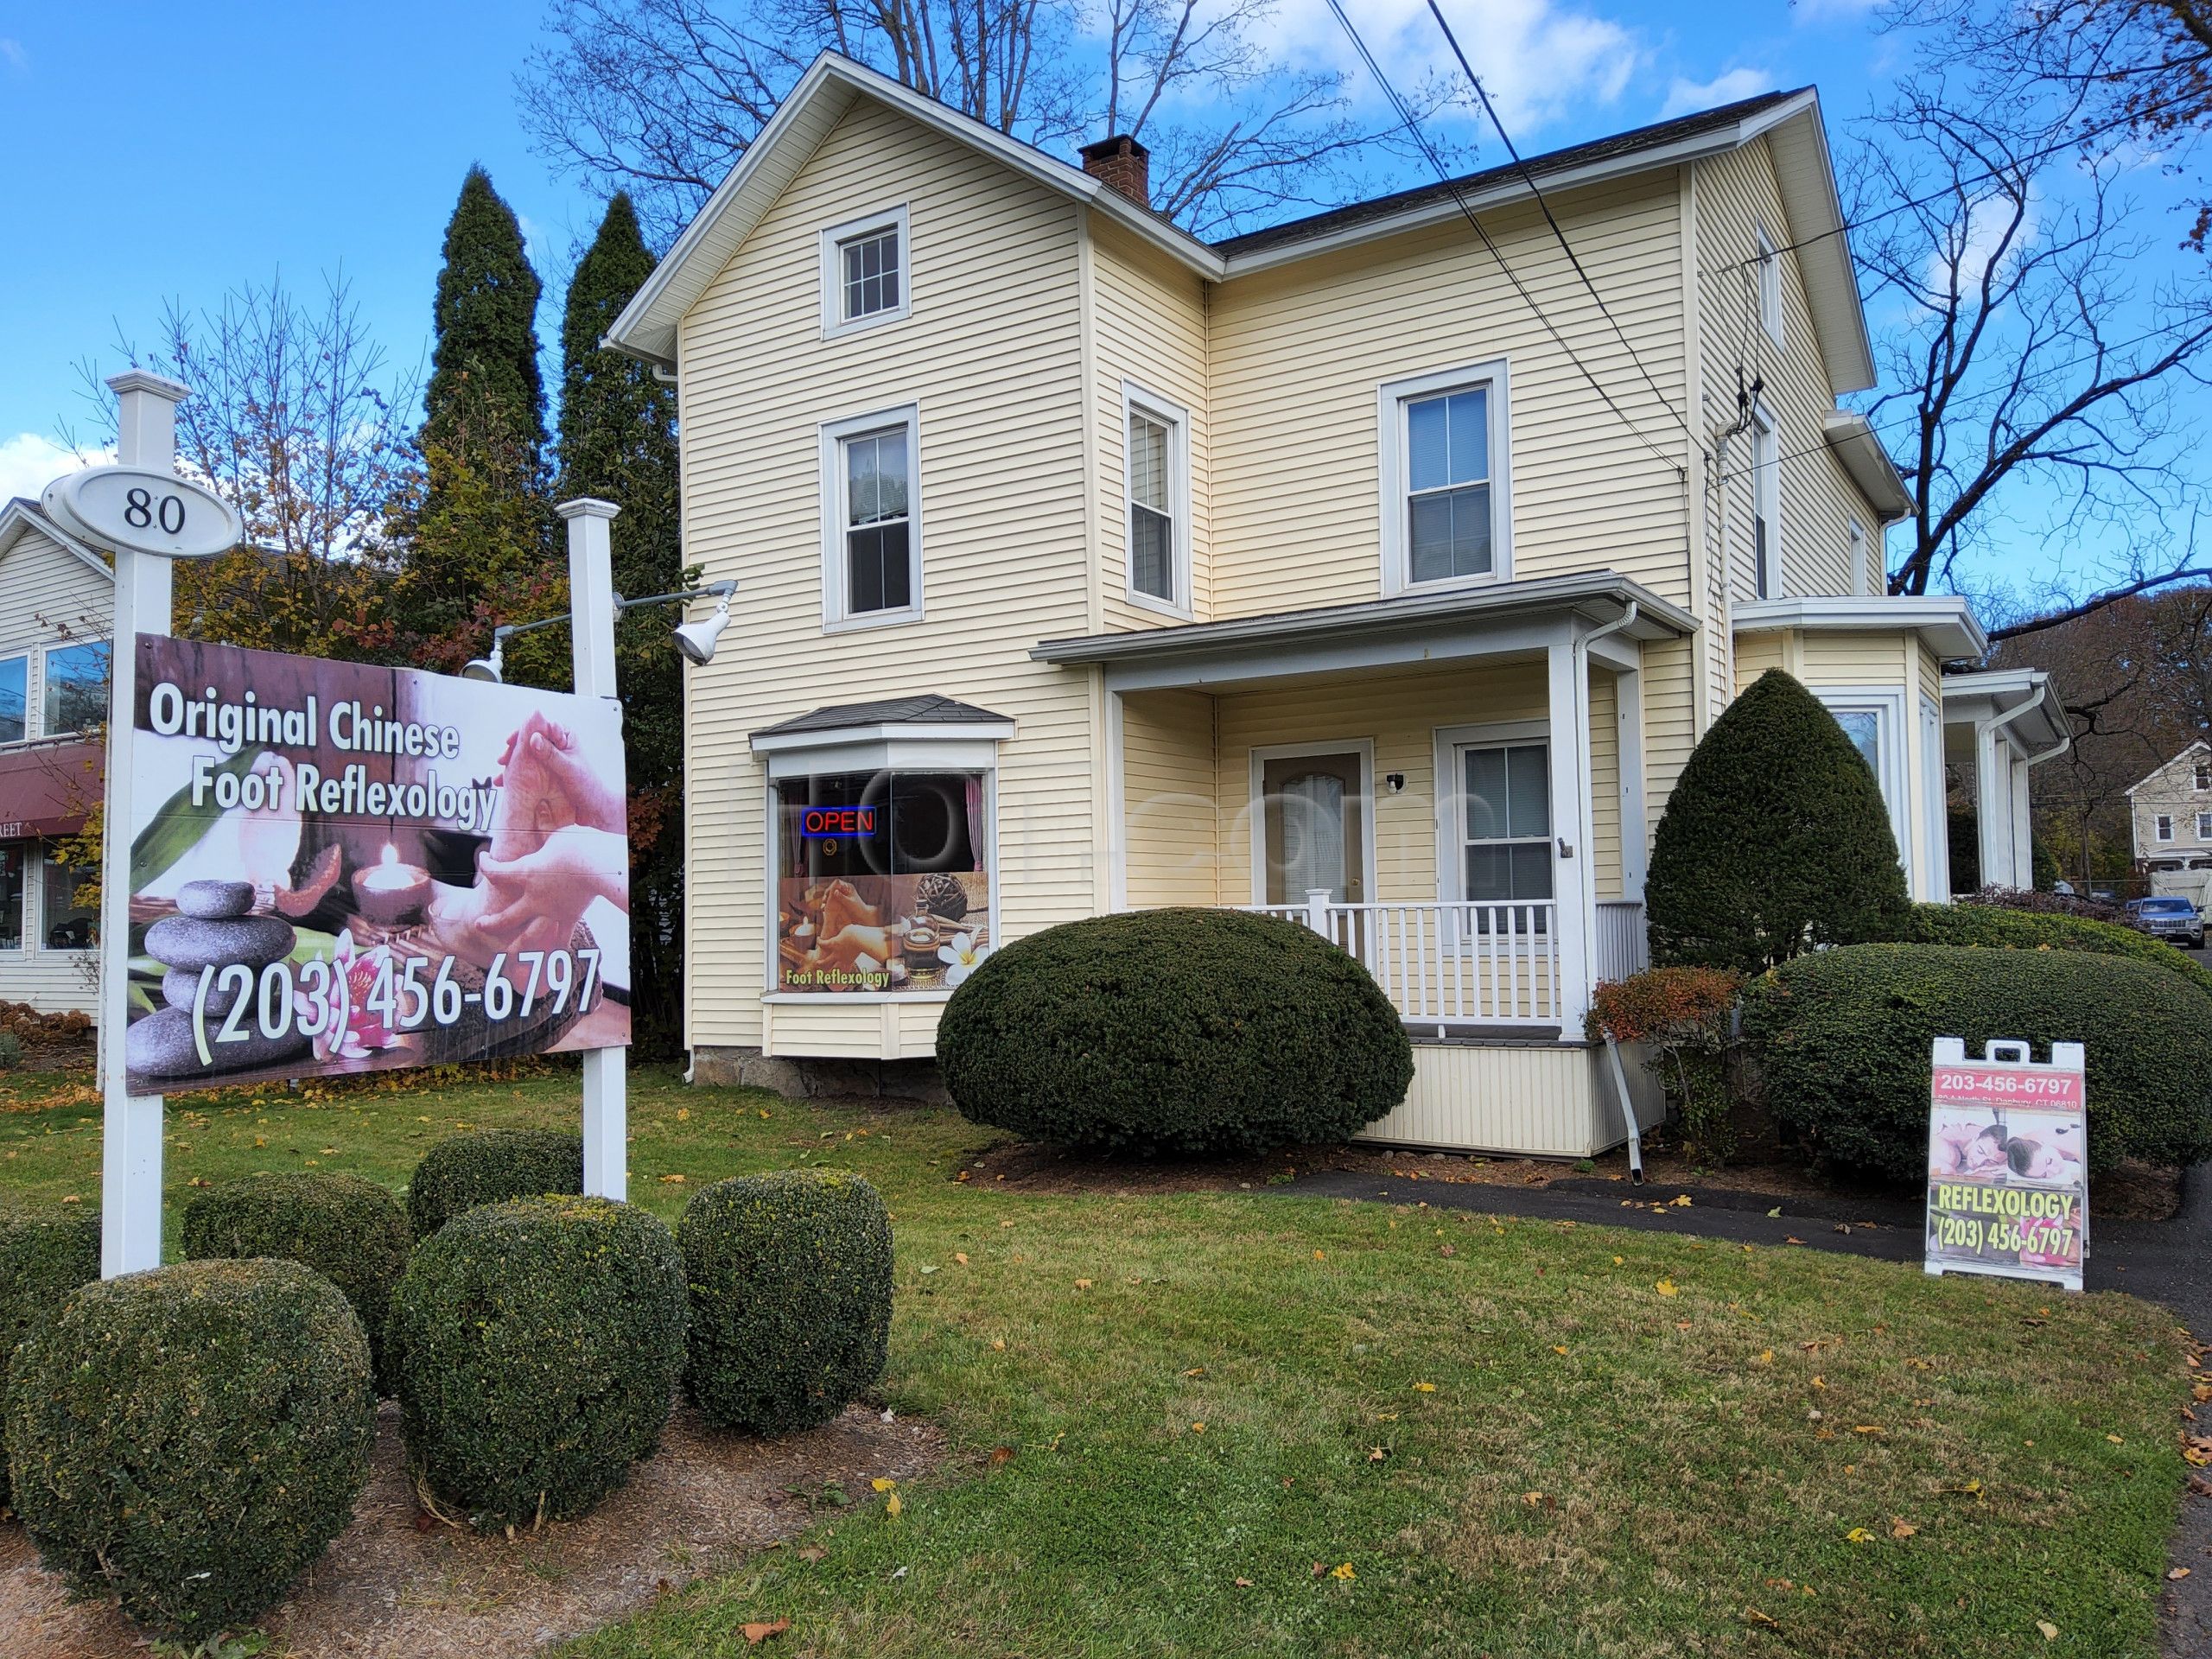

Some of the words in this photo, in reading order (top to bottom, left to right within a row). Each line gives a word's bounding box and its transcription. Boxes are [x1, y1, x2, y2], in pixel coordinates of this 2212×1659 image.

[124, 487, 186, 535] 80
[149, 682, 317, 754] Original
[329, 700, 460, 760] Chinese
[192, 754, 284, 810] Foot
[295, 763, 498, 832] Reflexology
[805, 811, 873, 832] OPEN
[785, 968, 812, 985] Foot
[816, 968, 890, 988] Reflexology
[192, 958, 348, 1066] (203)
[366, 948, 601, 1029] 456-6797
[1940, 1074, 2073, 1095] 203-456-6797
[1938, 1184, 2074, 1220] REFLEXOLOGY
[1938, 1216, 1984, 1255] (203)
[1987, 1222, 2074, 1256] 456-6797
